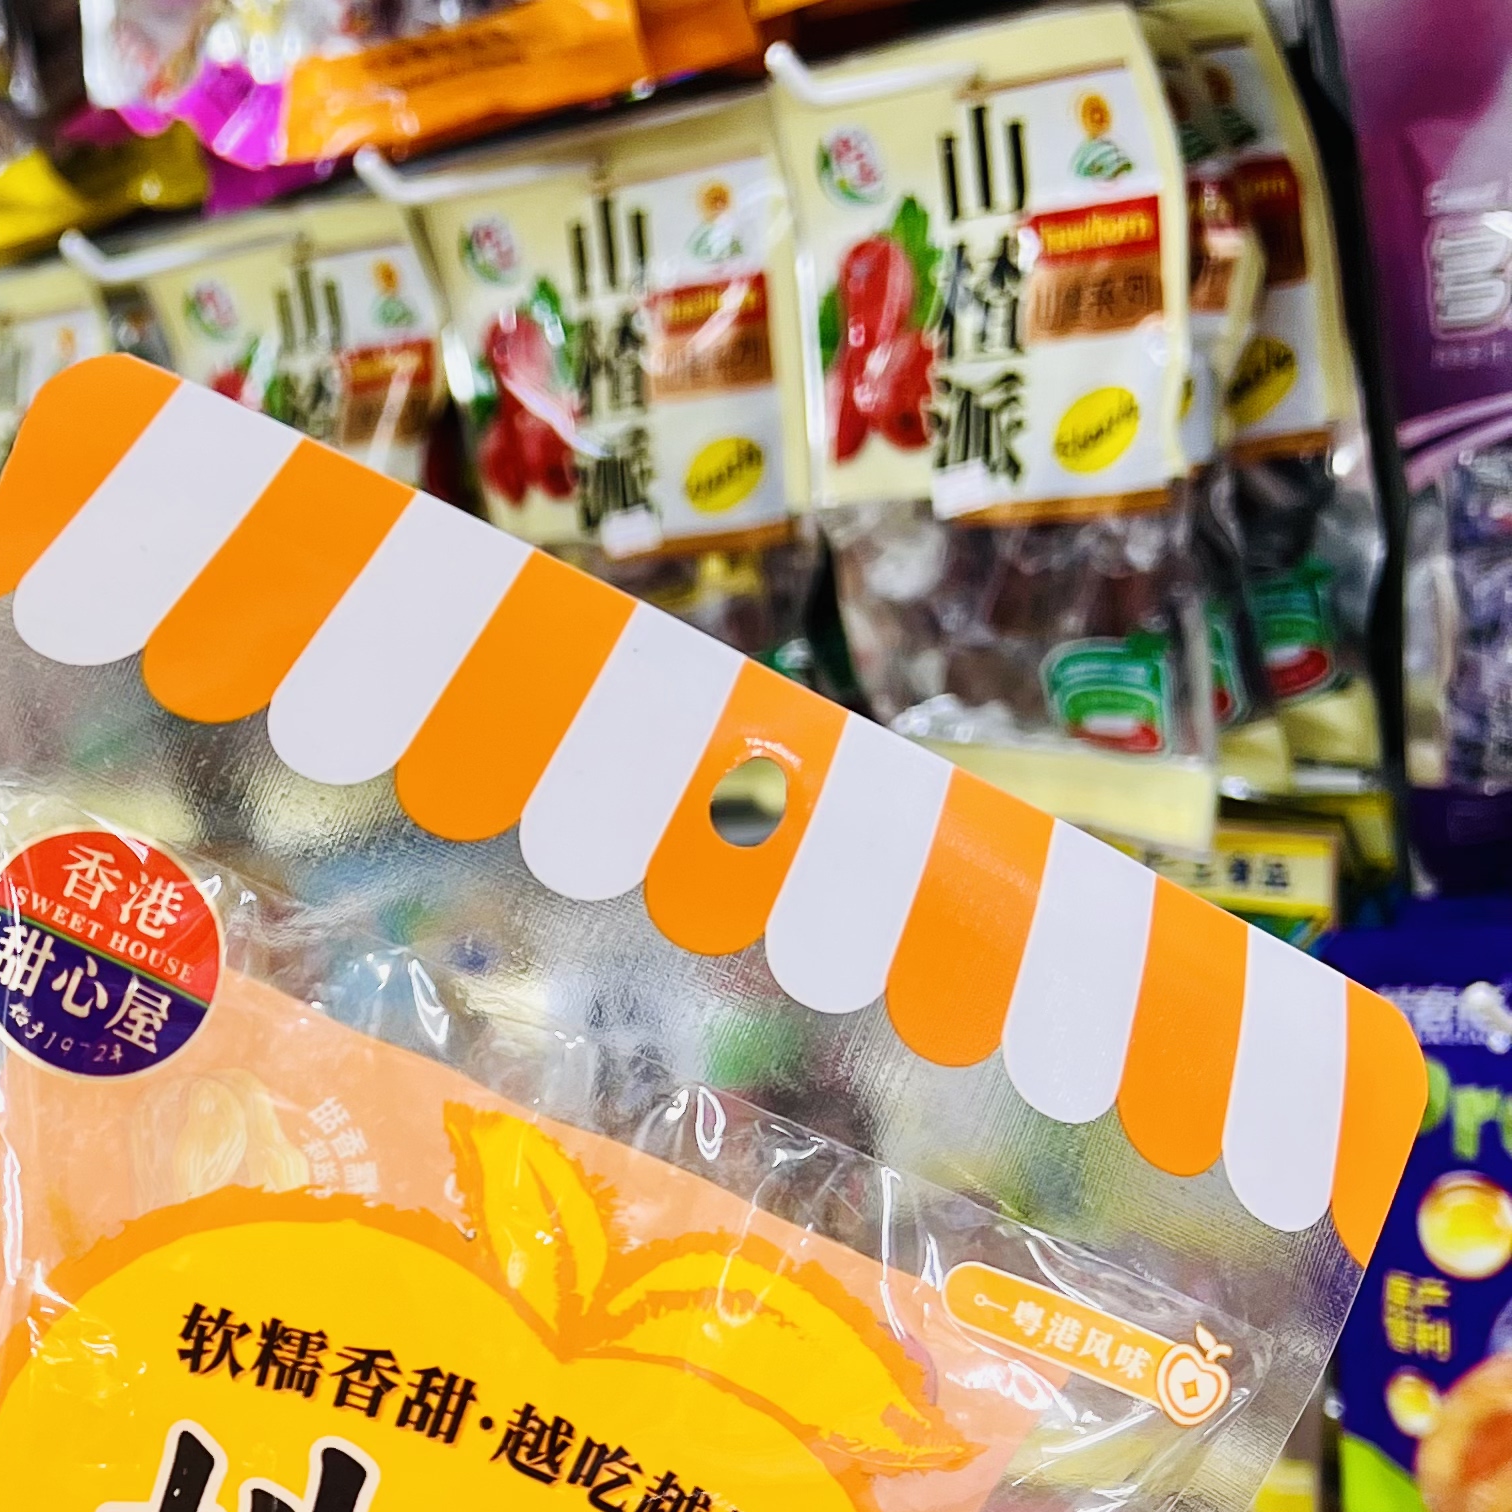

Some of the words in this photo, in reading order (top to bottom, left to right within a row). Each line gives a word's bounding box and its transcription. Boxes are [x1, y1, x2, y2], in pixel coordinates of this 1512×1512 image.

[15, 885, 104, 941] SWEET
[107, 930, 195, 985] HOUSE
[60, 843, 185, 940] 香港
[1008, 1299, 1154, 1383] 粤港风味
